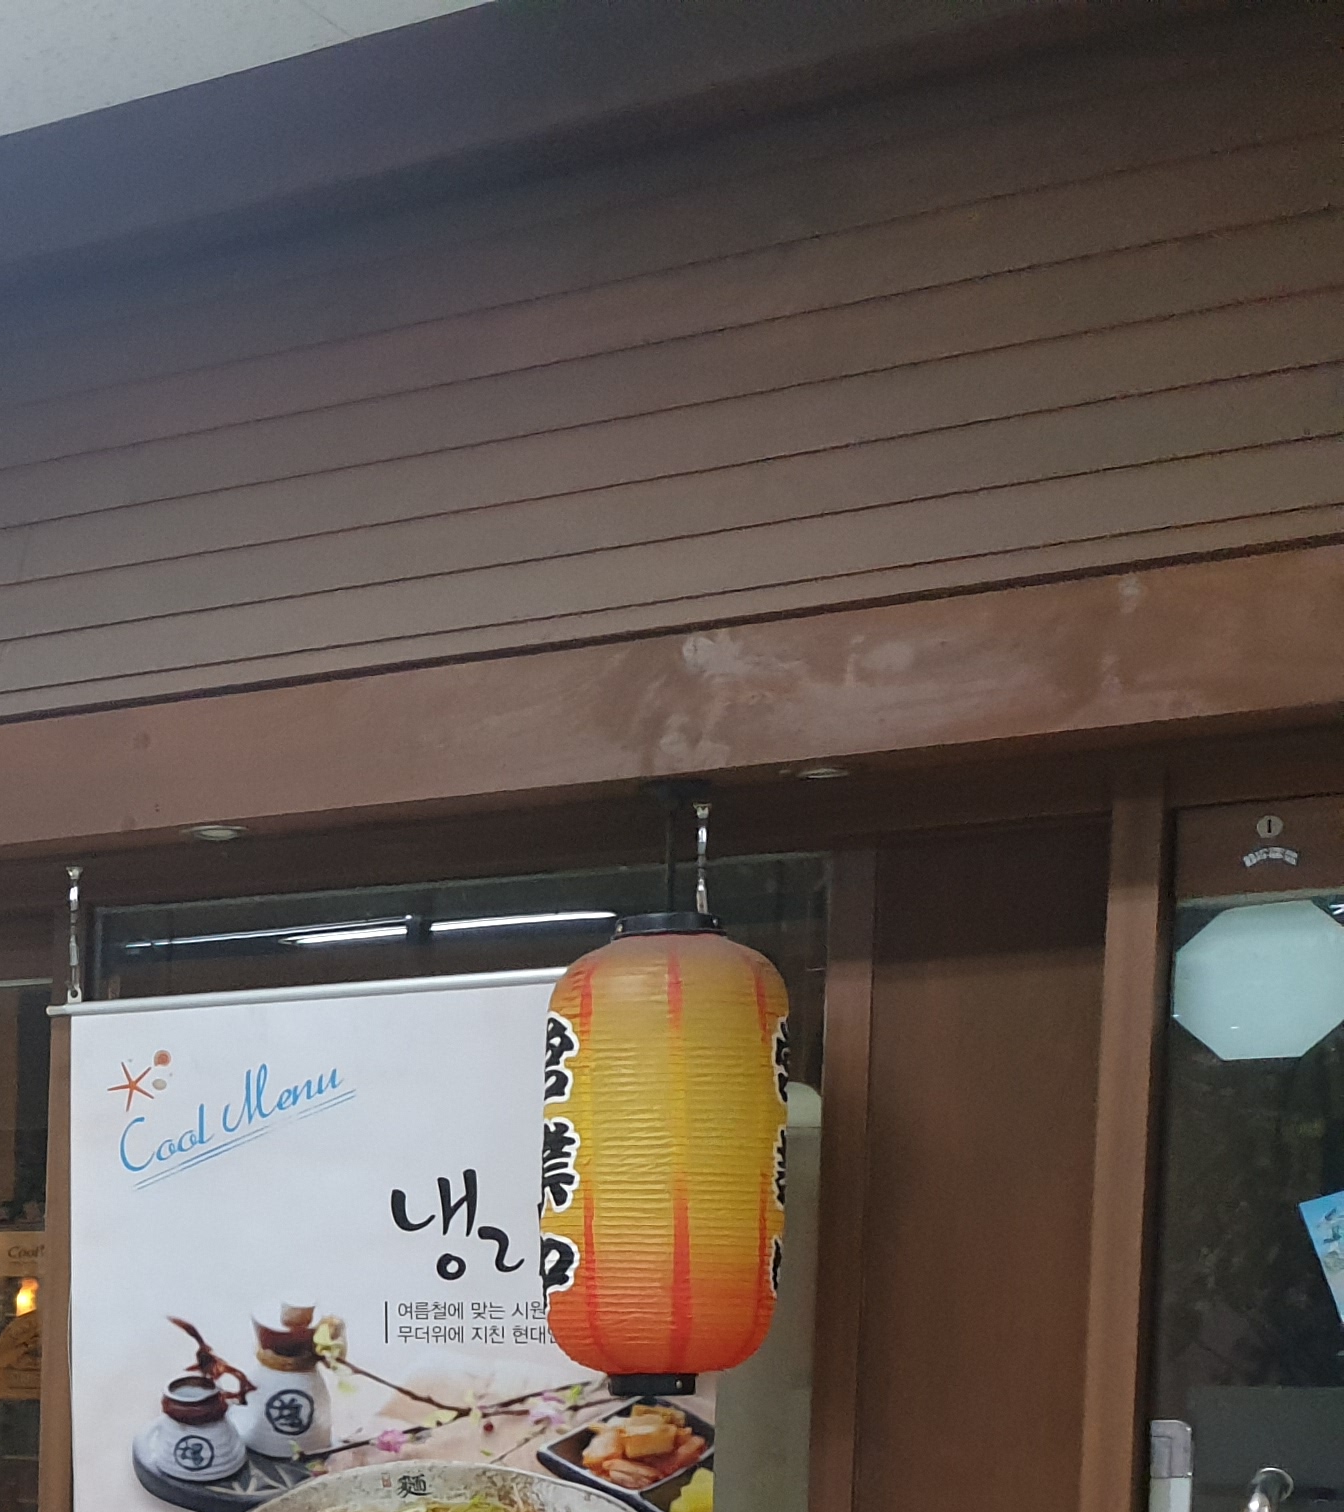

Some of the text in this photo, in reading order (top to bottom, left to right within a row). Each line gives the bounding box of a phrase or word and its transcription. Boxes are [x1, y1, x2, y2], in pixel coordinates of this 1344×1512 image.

[120, 1062, 345, 1173] Cool Menu
[397, 1301, 464, 1321] 여름철에
[470, 1301, 506, 1320] 맞는
[397, 1325, 464, 1344] 무더위에
[471, 1325, 506, 1344] 지친
